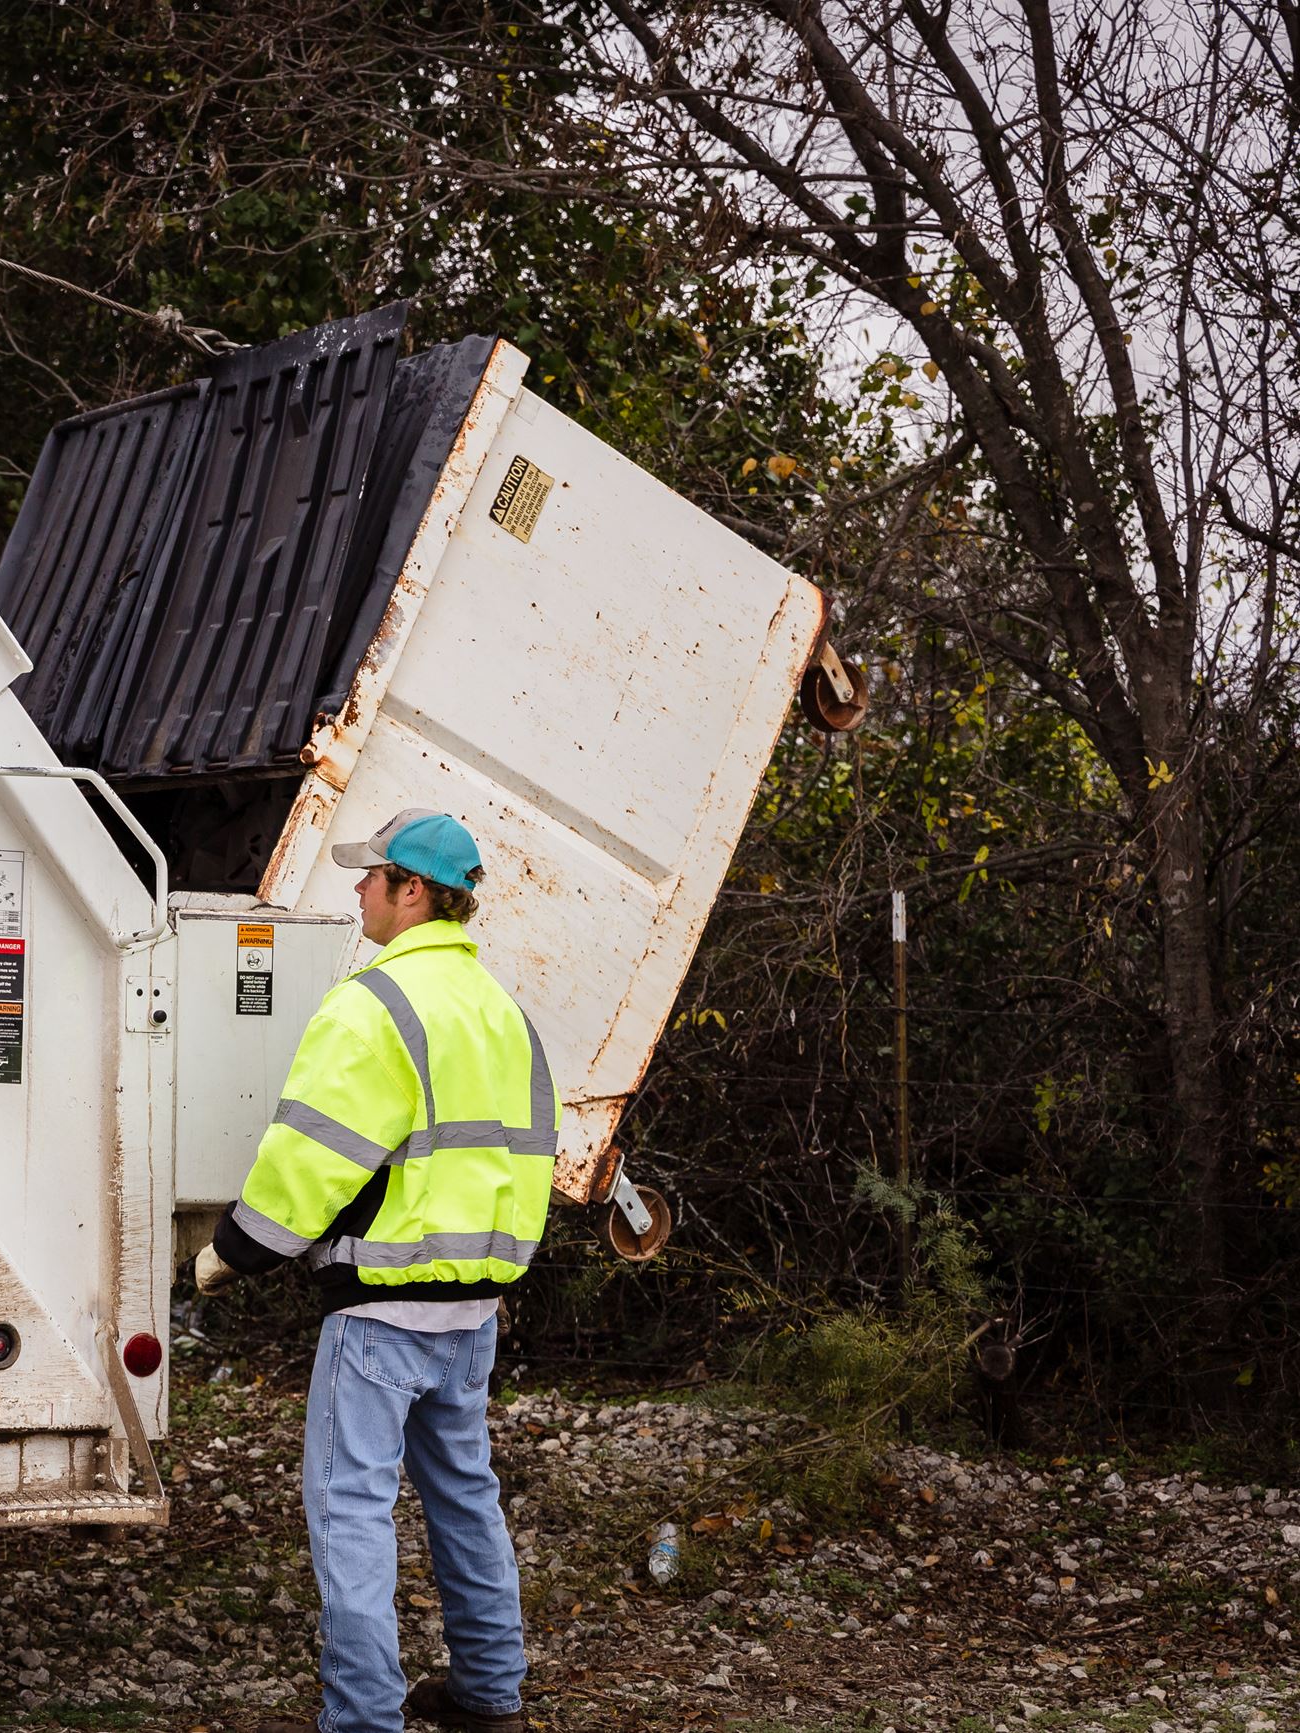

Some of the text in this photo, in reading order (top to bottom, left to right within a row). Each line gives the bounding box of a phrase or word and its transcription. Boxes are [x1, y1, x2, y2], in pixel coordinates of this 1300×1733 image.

[496, 457, 527, 509] CAUTION
[506, 516, 514, 525] DO
[511, 504, 519, 516] NOT
[517, 488, 526, 503] PLAY
[527, 469, 534, 480] ON
[509, 469, 542, 534] OR AROUND OR OCCUPY
[520, 482, 543, 528] THIS CONTAINER
[524, 484, 550, 536] FOR ANY PURPOSE
